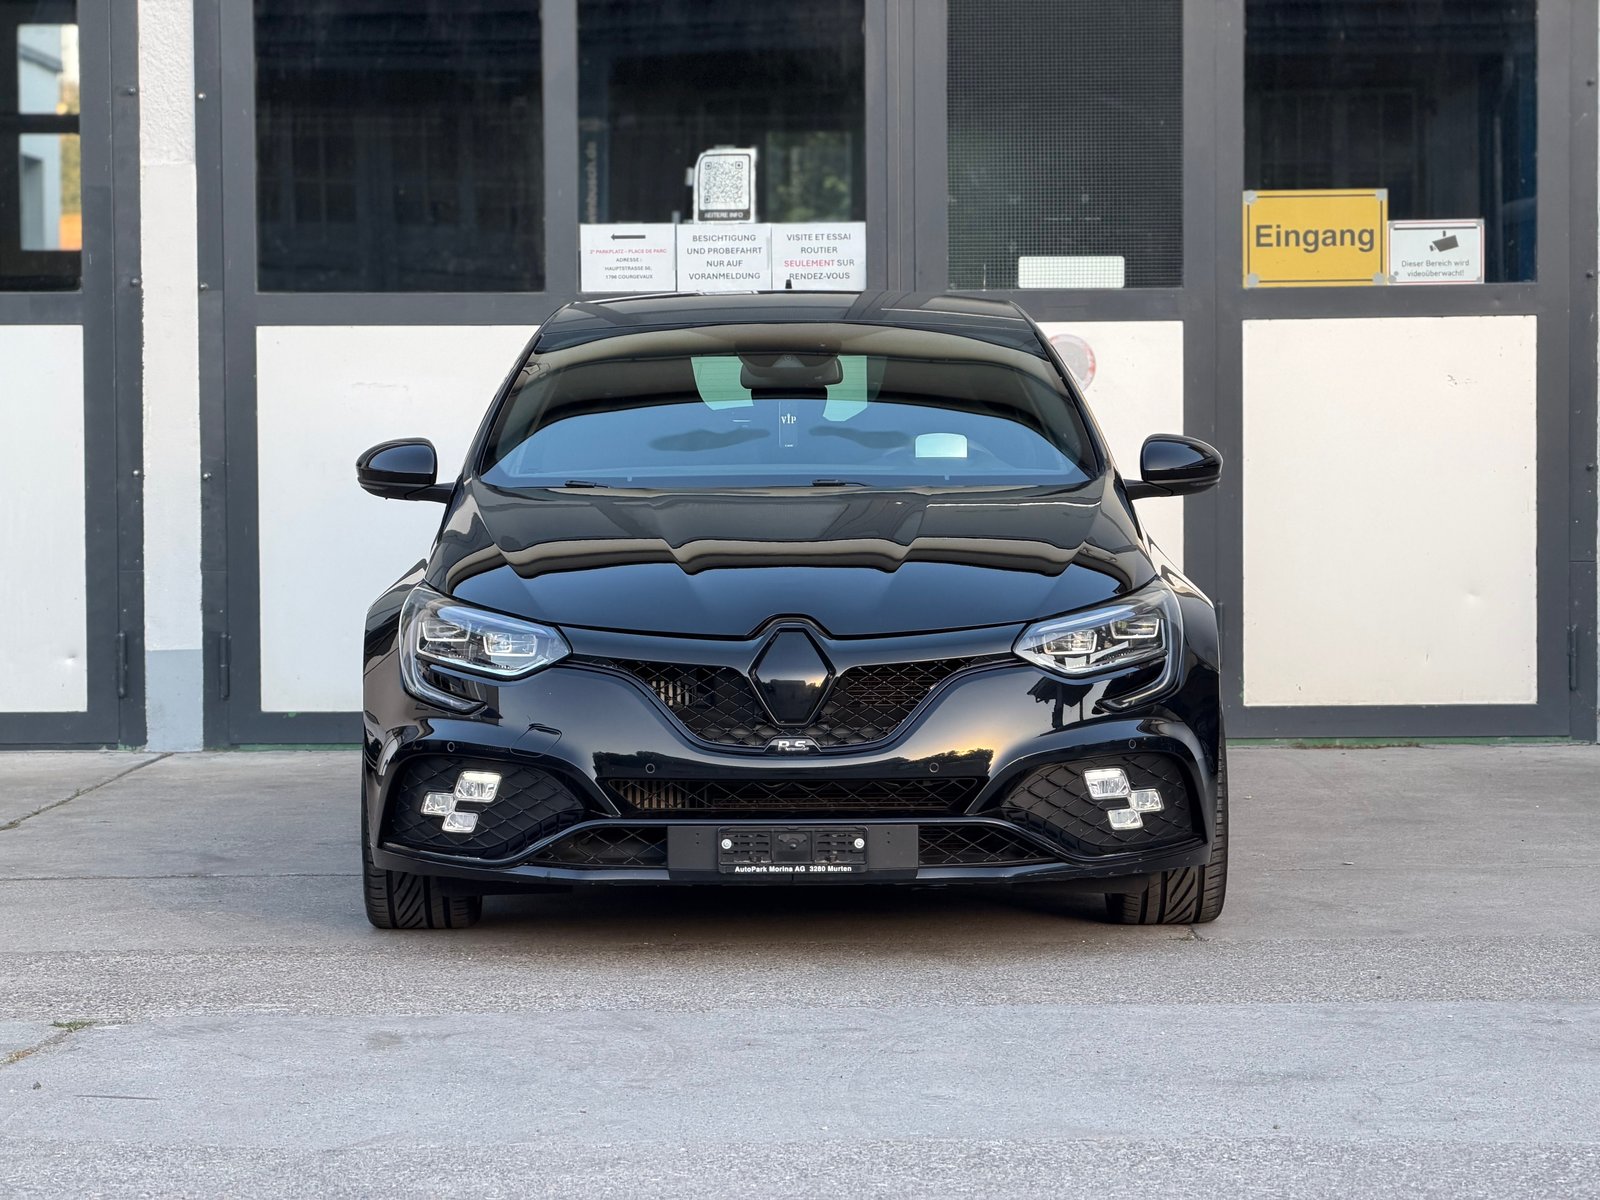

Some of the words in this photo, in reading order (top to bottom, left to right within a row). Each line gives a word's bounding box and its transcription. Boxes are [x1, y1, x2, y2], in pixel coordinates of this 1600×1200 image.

[692, 234, 757, 242] BESICHTIGUNG
[786, 233, 813, 241] VISITE
[815, 233, 825, 241] ET
[826, 233, 851, 241] ESSAI
[1255, 224, 1375, 253] Eingang
[686, 247, 706, 255] UND
[707, 246, 763, 254] PROBEFAHRT
[800, 246, 838, 254] ROUTIER
[784, 259, 835, 268] SEULEMENT
[688, 272, 761, 280] VORANMELDUNG
[789, 272, 850, 280] RENDEZ-VOUS
